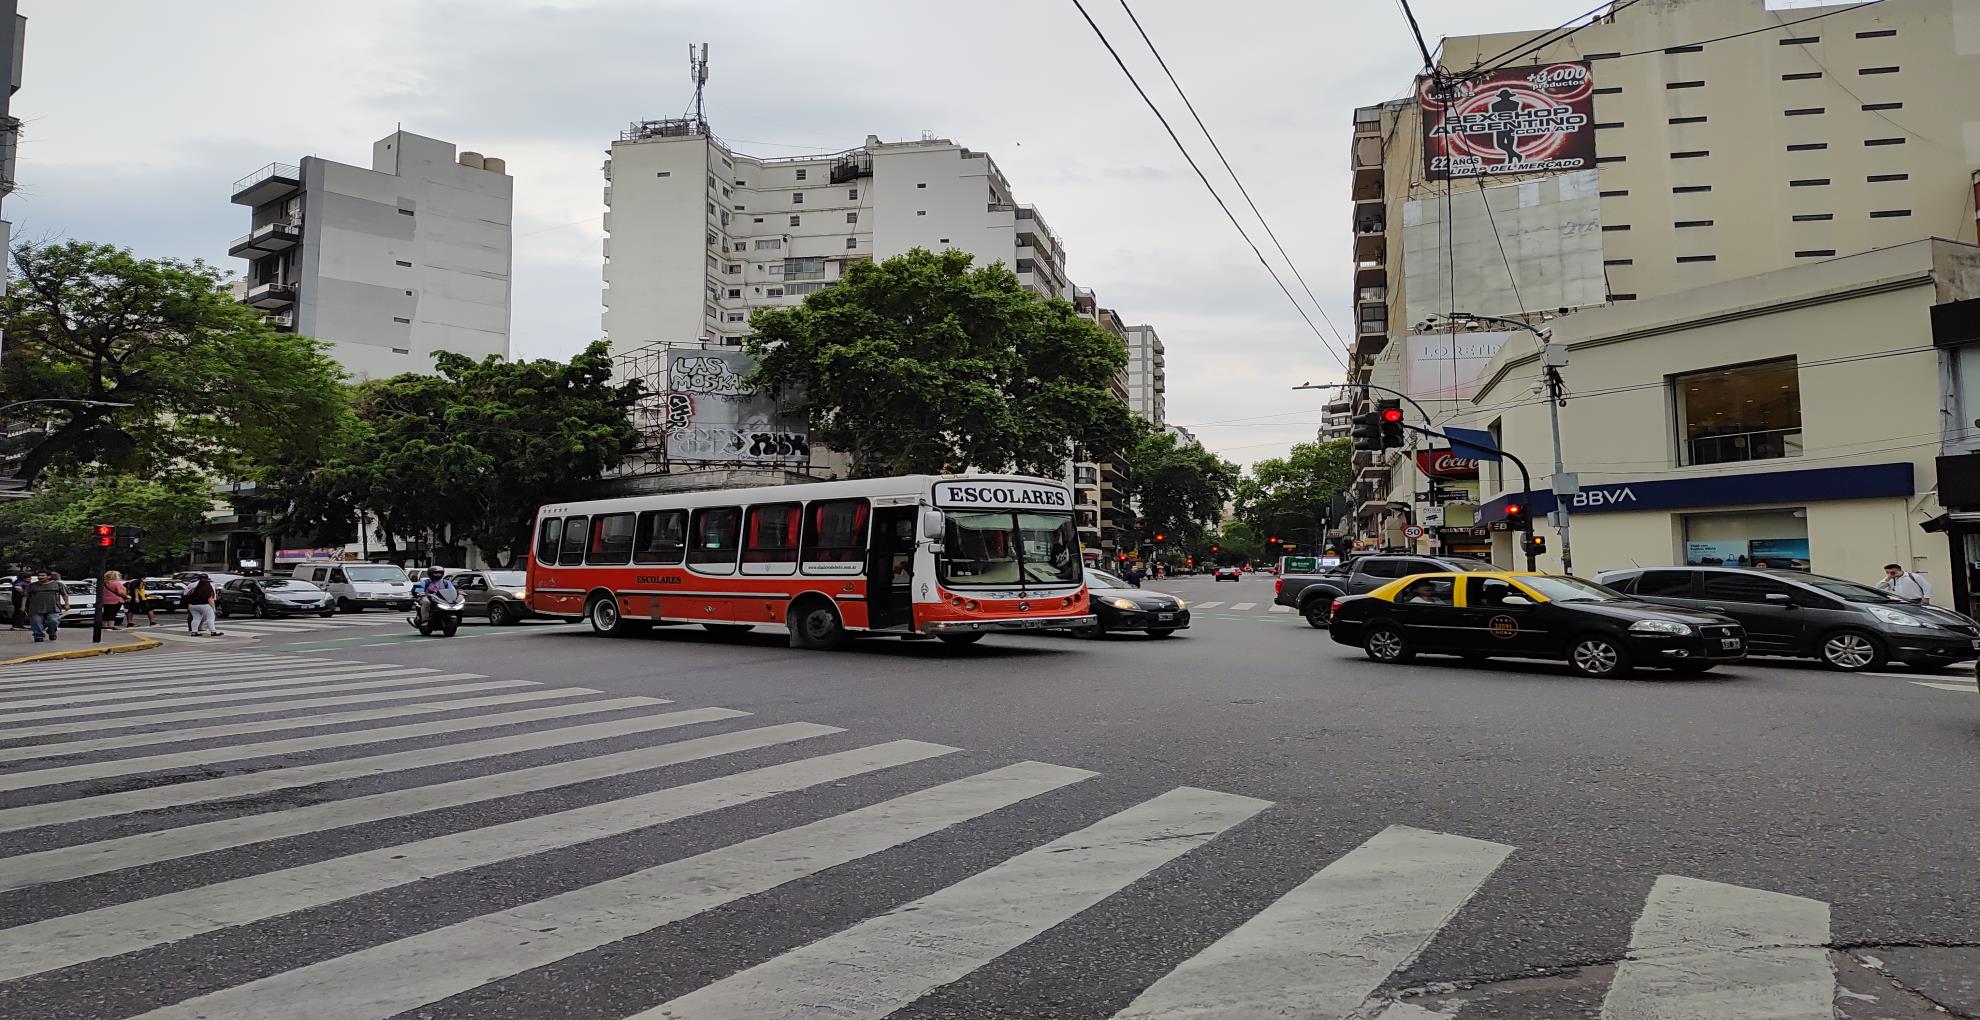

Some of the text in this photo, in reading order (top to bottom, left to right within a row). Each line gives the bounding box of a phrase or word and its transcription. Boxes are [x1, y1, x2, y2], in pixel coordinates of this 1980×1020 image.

[1532, 79, 1585, 91] productos
[1446, 106, 1570, 126] SEXSHOP
[1430, 115, 1585, 137] ARGENTINO
[1490, 163, 1514, 172] DEL
[1517, 158, 1582, 171] MERCADO
[676, 356, 724, 376] LAS
[1434, 454, 1468, 472] Coca
[947, 486, 1066, 506] ESCOLARES
[1573, 487, 1637, 507] BBVA
[1406, 528, 1420, 536] 50
[636, 575, 682, 585] ESCOLARES
